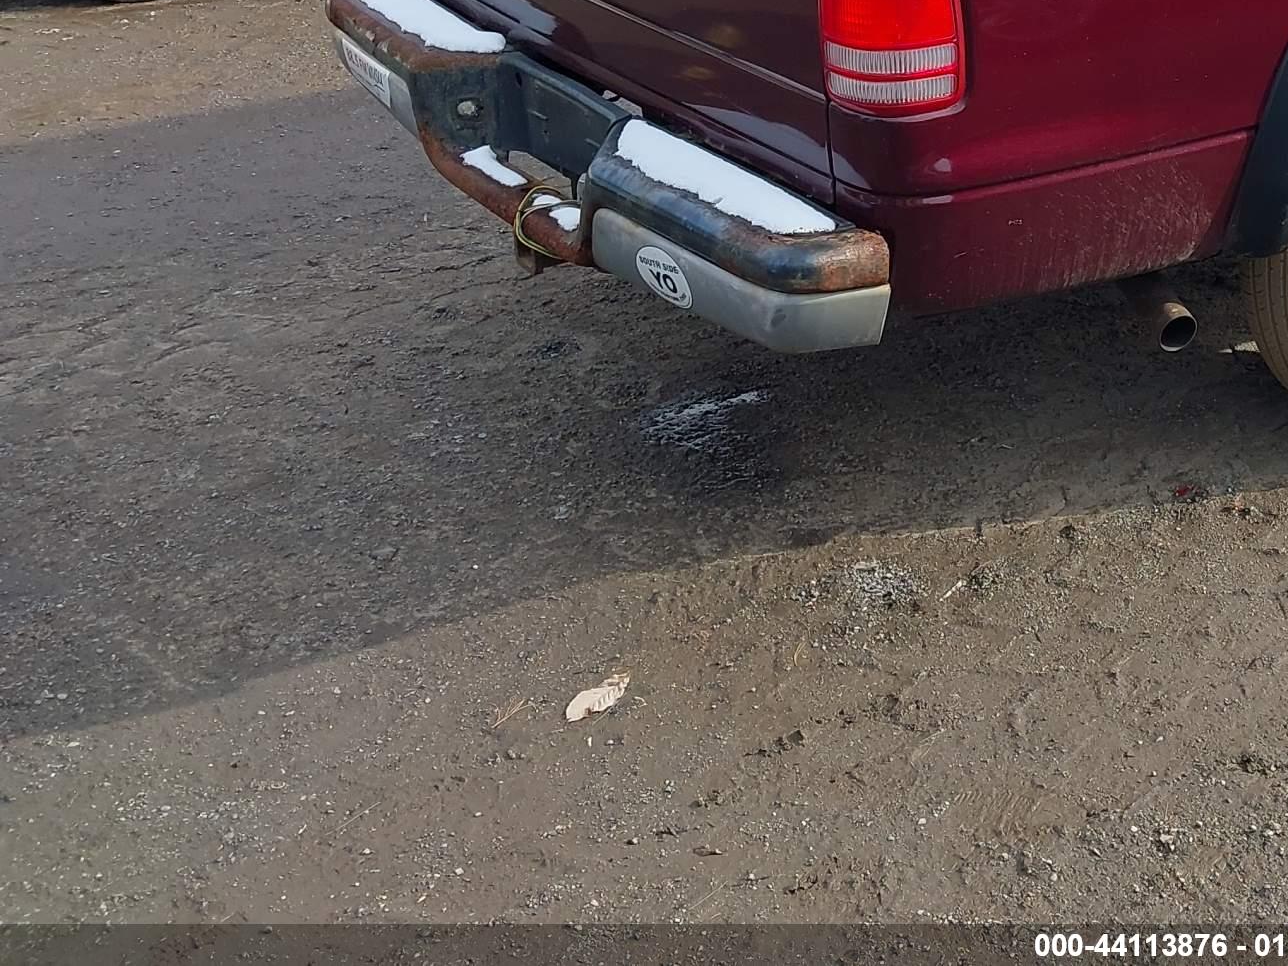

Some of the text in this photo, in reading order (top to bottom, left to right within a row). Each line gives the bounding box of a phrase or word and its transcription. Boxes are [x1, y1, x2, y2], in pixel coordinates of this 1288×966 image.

[638, 255, 680, 275] SOUTH SIDE
[648, 268, 678, 294] YO
